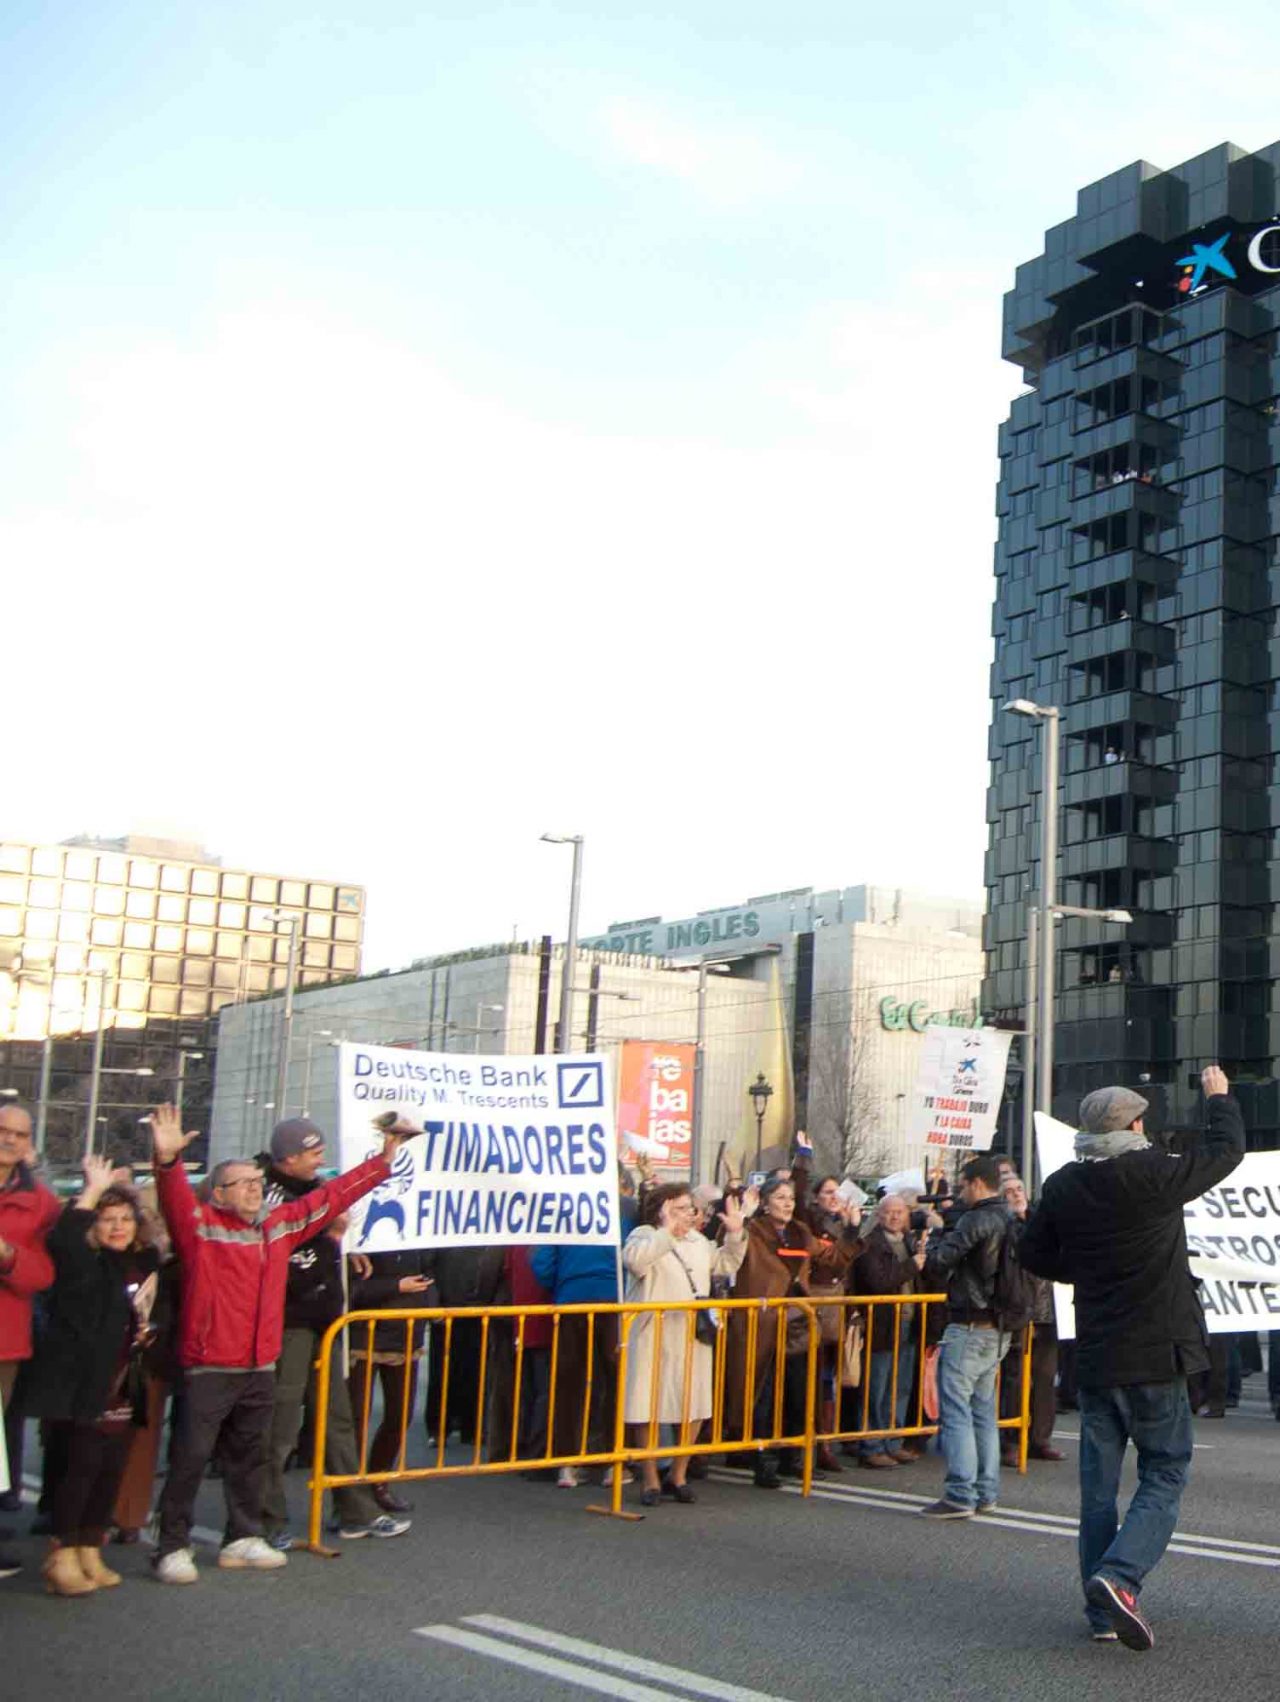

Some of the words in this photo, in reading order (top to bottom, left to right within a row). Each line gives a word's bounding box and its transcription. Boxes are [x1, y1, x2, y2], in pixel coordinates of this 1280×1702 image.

[667, 911, 761, 950] INGLES
[354, 1054, 471, 1086] Deutsche
[480, 1065, 549, 1087] Bank
[353, 1082, 426, 1107] Quality
[457, 1090, 549, 1109] Trescents
[423, 1120, 607, 1175] TIMADORES
[416, 1189, 611, 1237] FINANCIEROS
